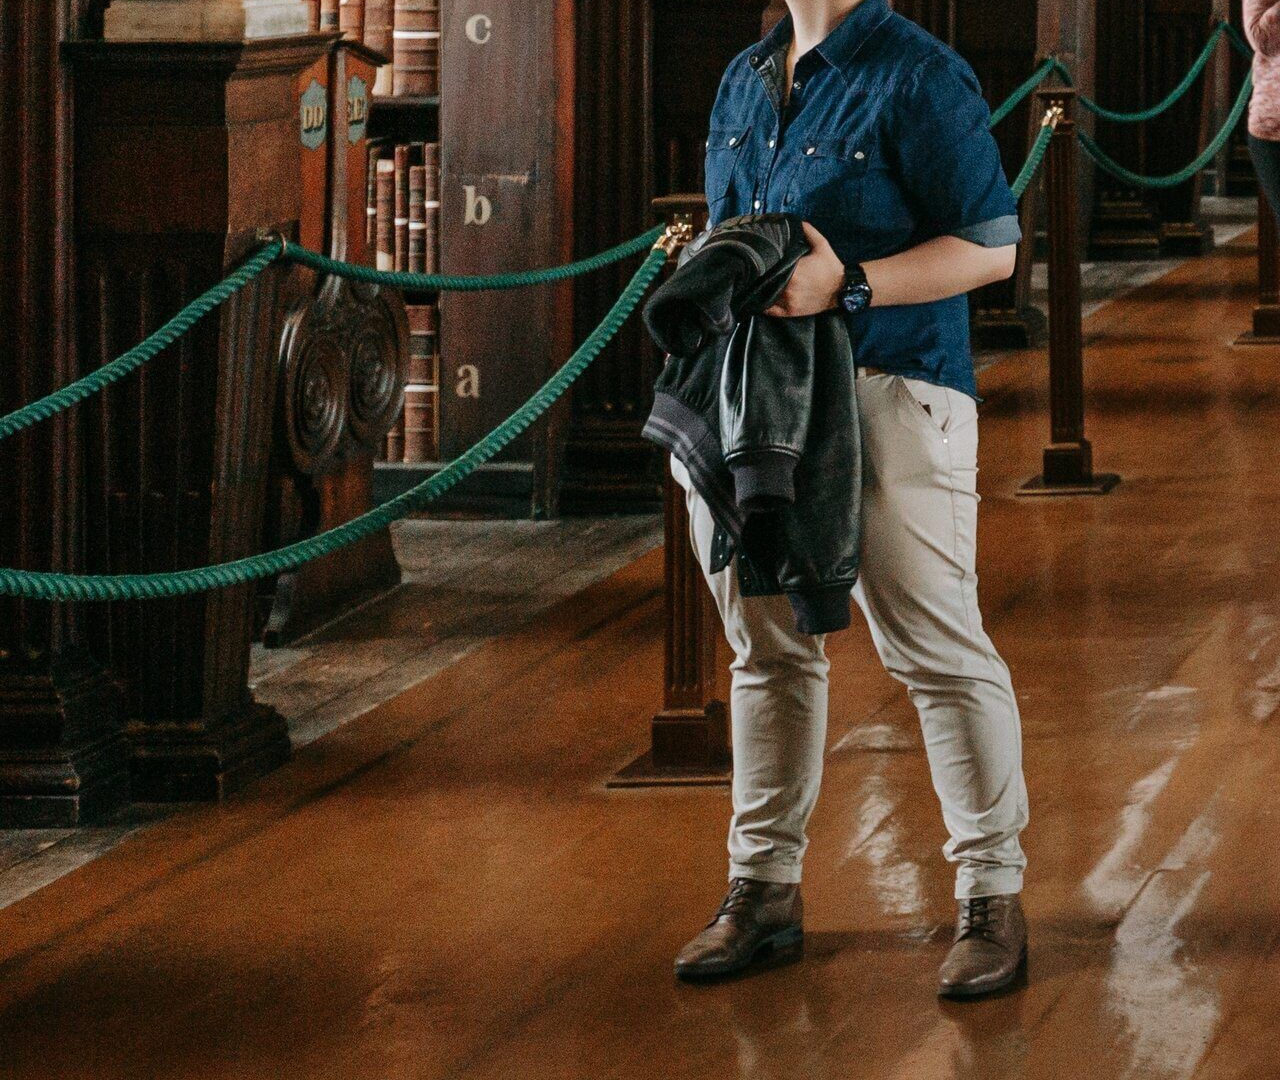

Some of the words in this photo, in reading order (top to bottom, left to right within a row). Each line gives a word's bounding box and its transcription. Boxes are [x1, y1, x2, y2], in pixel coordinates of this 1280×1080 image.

[465, 14, 491, 43] c
[463, 186, 491, 224] b
[456, 365, 479, 397] a
